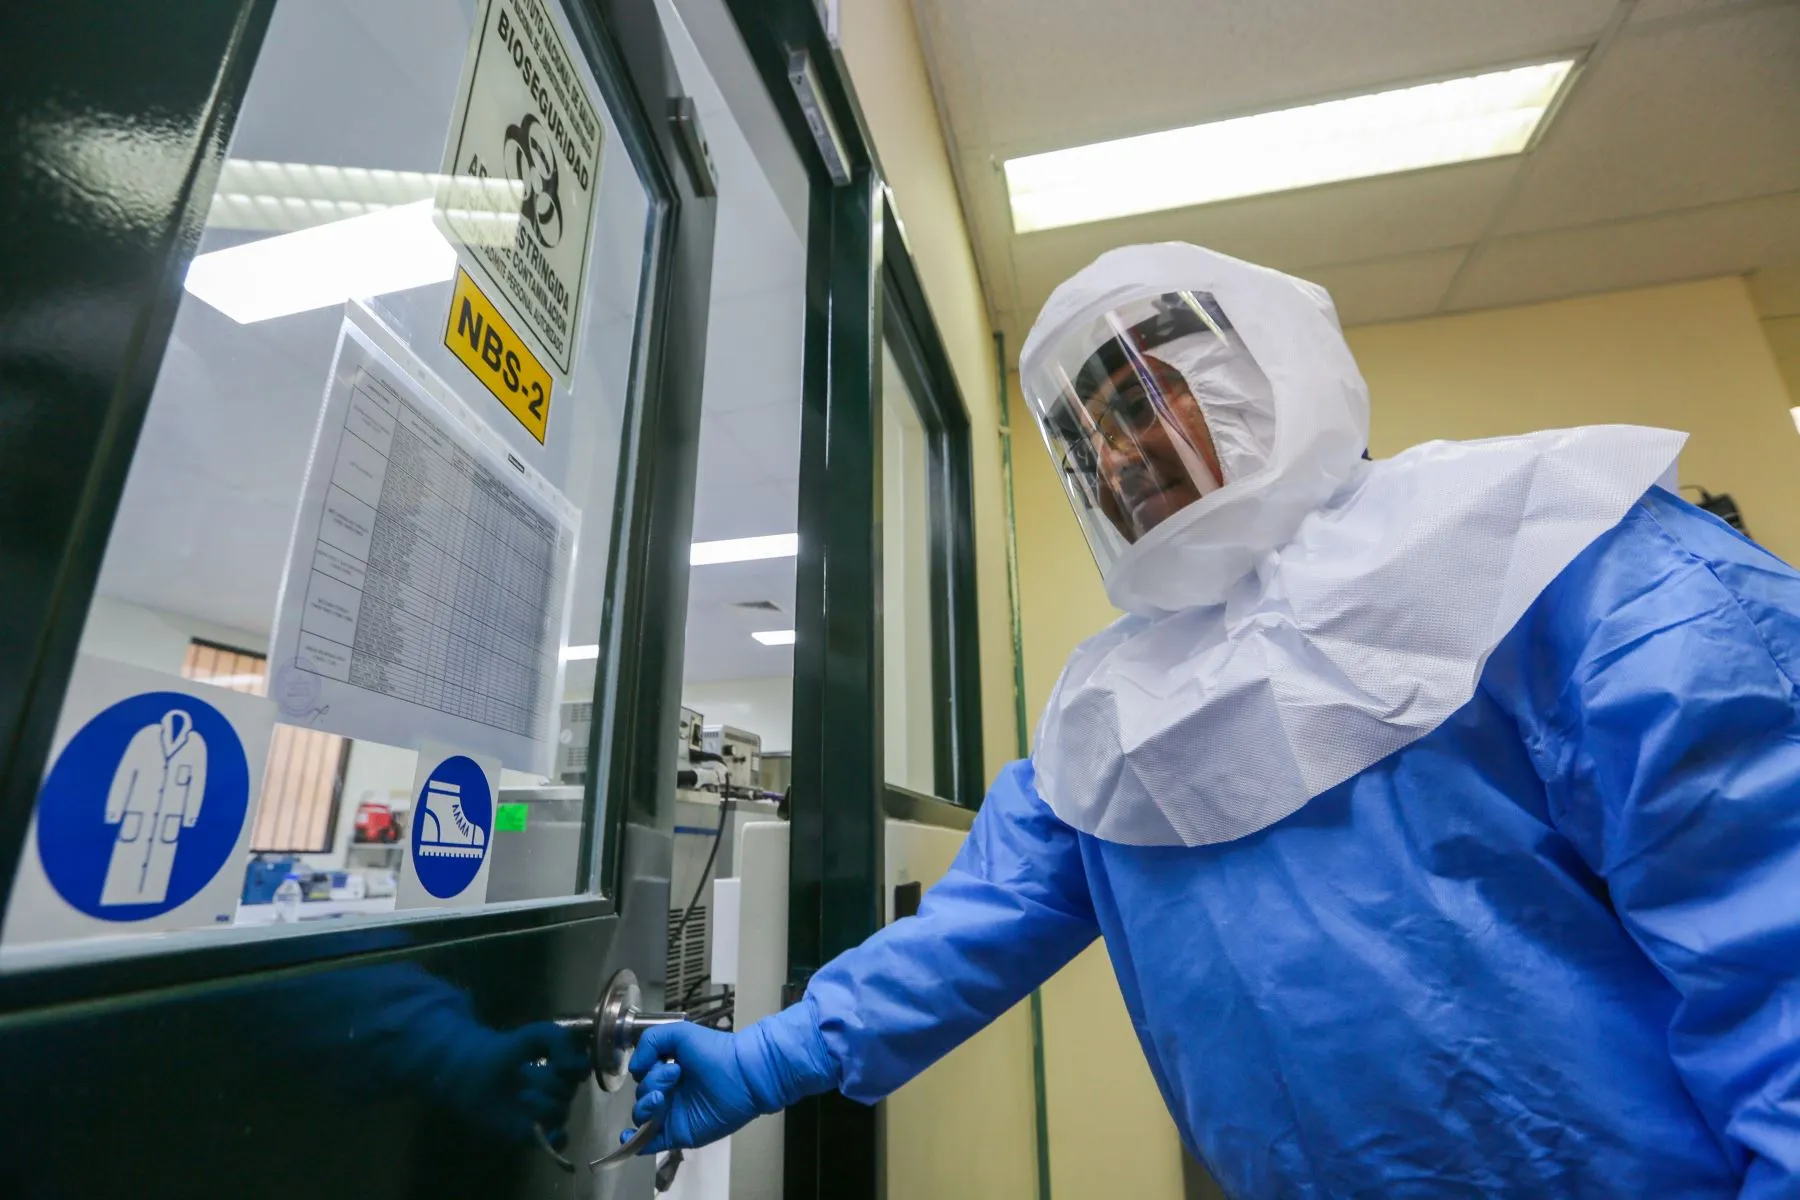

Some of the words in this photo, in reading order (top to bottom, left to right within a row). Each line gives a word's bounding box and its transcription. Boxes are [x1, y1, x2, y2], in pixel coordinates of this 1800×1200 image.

[497, 8, 588, 192] BIOSEGURIDAD
[506, 270, 533, 316] PERSONAL
[533, 307, 563, 356] AUTORIZADO
[512, 250, 566, 336] CONTAMINACION
[457, 296, 545, 421] NBS-2
